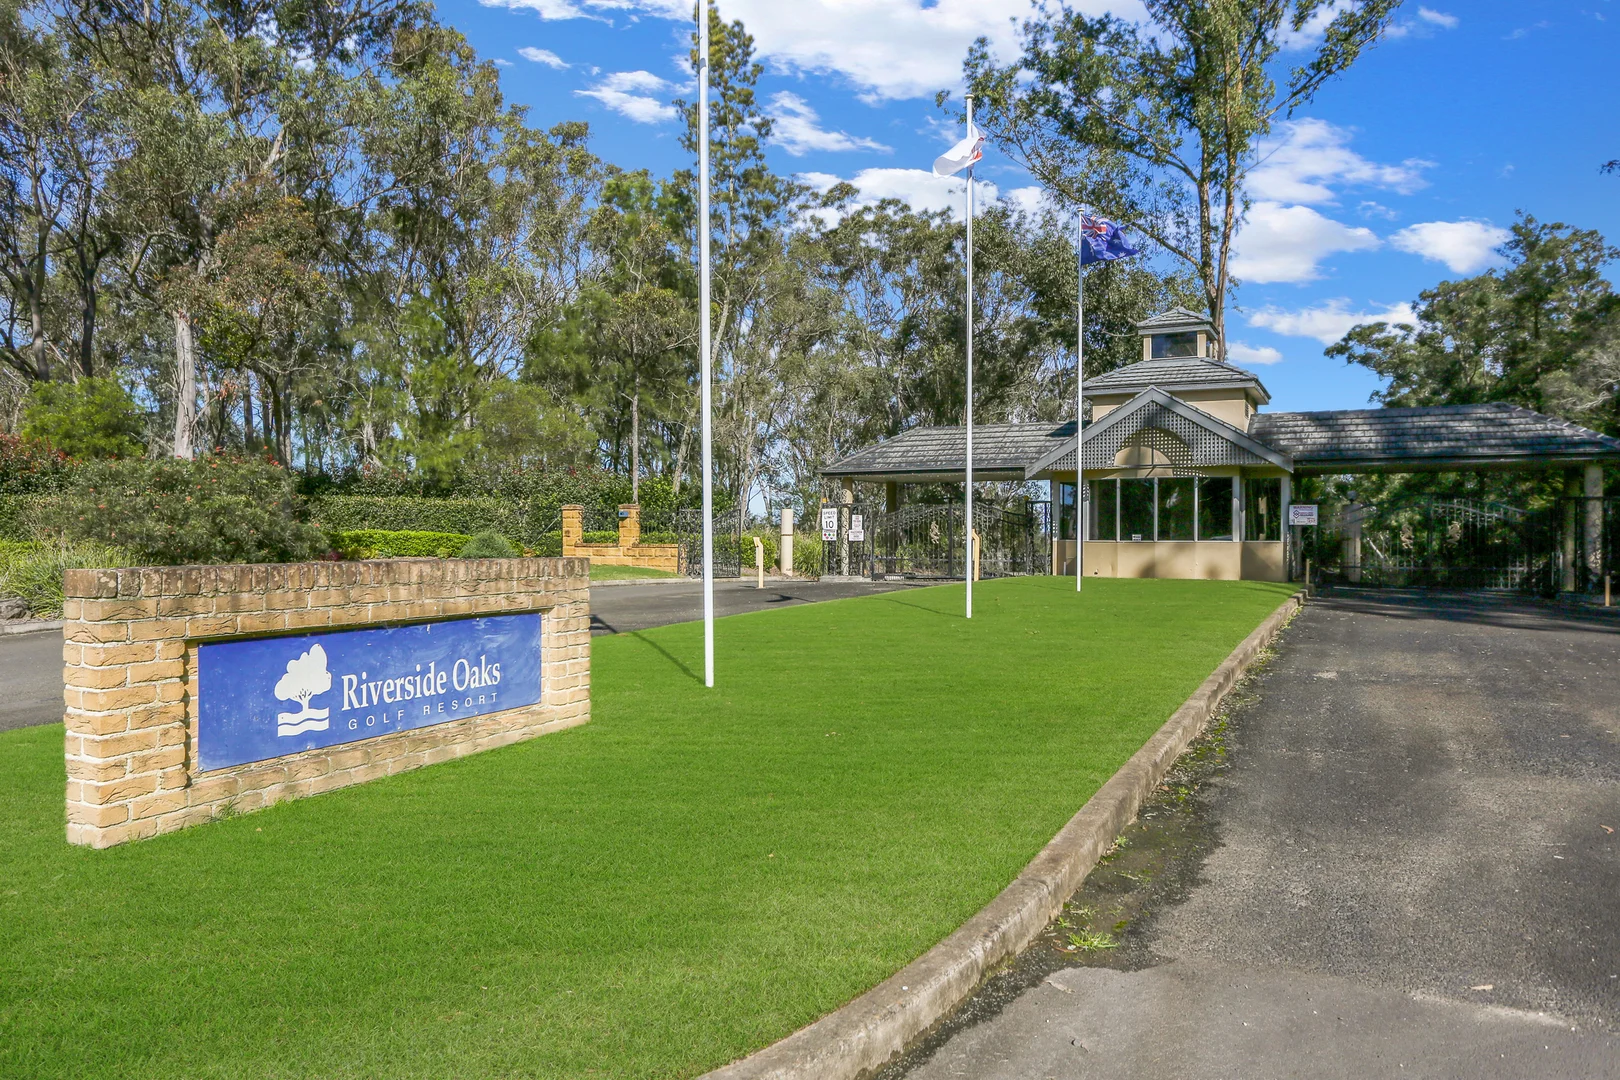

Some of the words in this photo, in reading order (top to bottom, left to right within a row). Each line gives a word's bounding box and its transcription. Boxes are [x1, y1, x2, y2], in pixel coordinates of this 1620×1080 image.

[825, 520, 834, 528] 10
[341, 661, 447, 711] Riverside
[452, 654, 501, 691] Oaks
[348, 709, 405, 730] GOLF
[423, 692, 498, 716] RESORT
